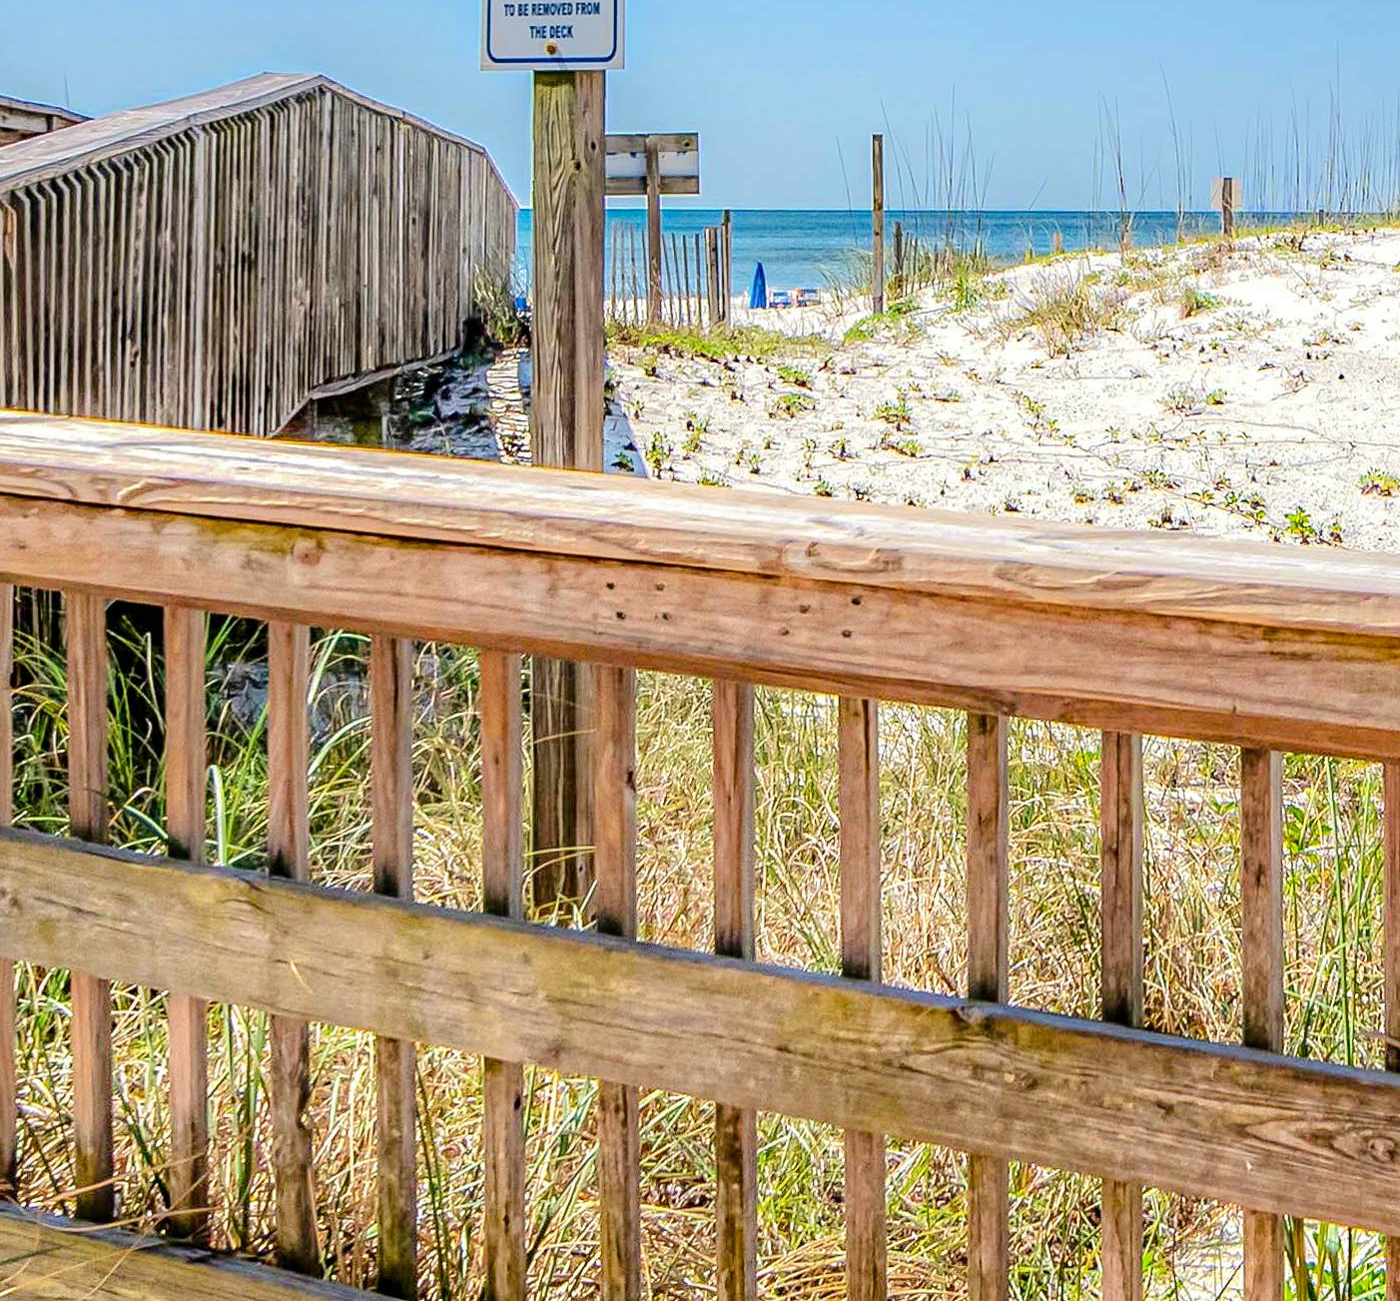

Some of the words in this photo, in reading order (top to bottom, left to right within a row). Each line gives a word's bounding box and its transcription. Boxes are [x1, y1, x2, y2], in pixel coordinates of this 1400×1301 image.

[504, 3, 516, 17] TO
[518, 3, 529, 16] BE
[532, 2, 573, 16] REMOVED
[576, 1, 601, 15] FROM
[529, 25, 547, 39] THE
[549, 25, 574, 39] DECK
